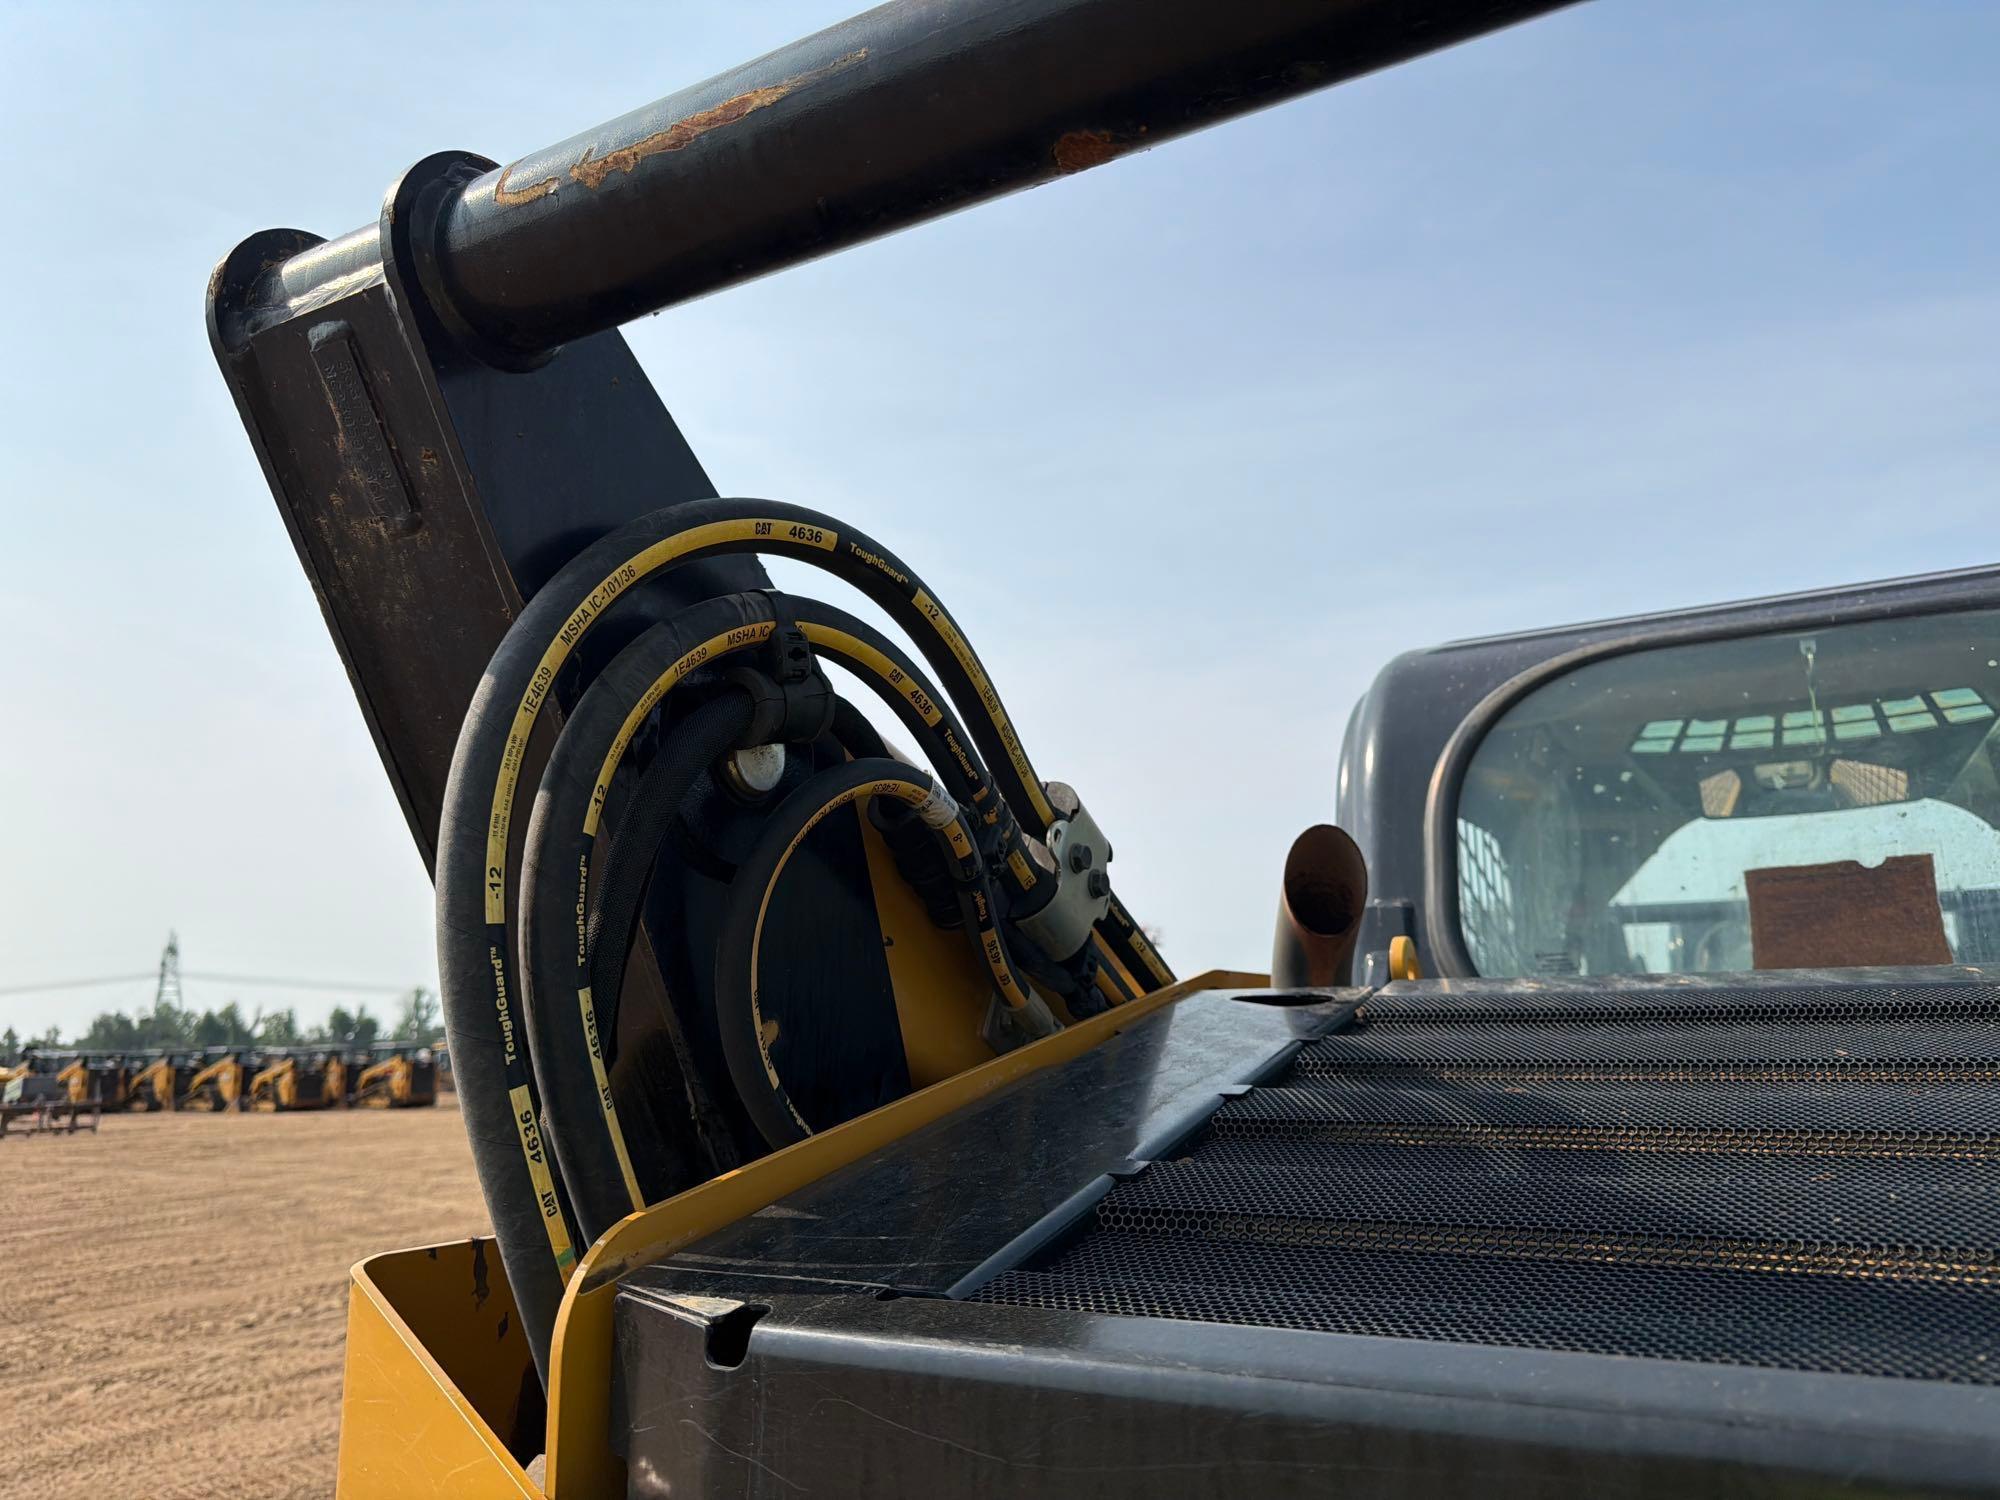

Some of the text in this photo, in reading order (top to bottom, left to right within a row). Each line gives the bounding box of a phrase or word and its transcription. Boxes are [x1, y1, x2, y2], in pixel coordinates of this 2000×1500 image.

[755, 522, 773, 535] CAT
[789, 525, 823, 543] 4636
[924, 603, 941, 620] -12
[523, 565, 636, 715] 1E4639 MSHA IC-101/36
[673, 647, 707, 678] 1E4639
[727, 630, 756, 647] MSHA
[889, 668, 905, 684] CAT
[910, 690, 933, 715] 4636
[982, 684, 999, 714] 1E4639
[1001, 722, 1014, 748] MSHA
[594, 783, 607, 814] -12
[489, 867, 502, 899] -12
[987, 939, 1001, 964] 4636
[585, 1009, 613, 1110] CAT 4636
[519, 1110, 543, 1164] 4636
[541, 1191, 558, 1218] CAT
